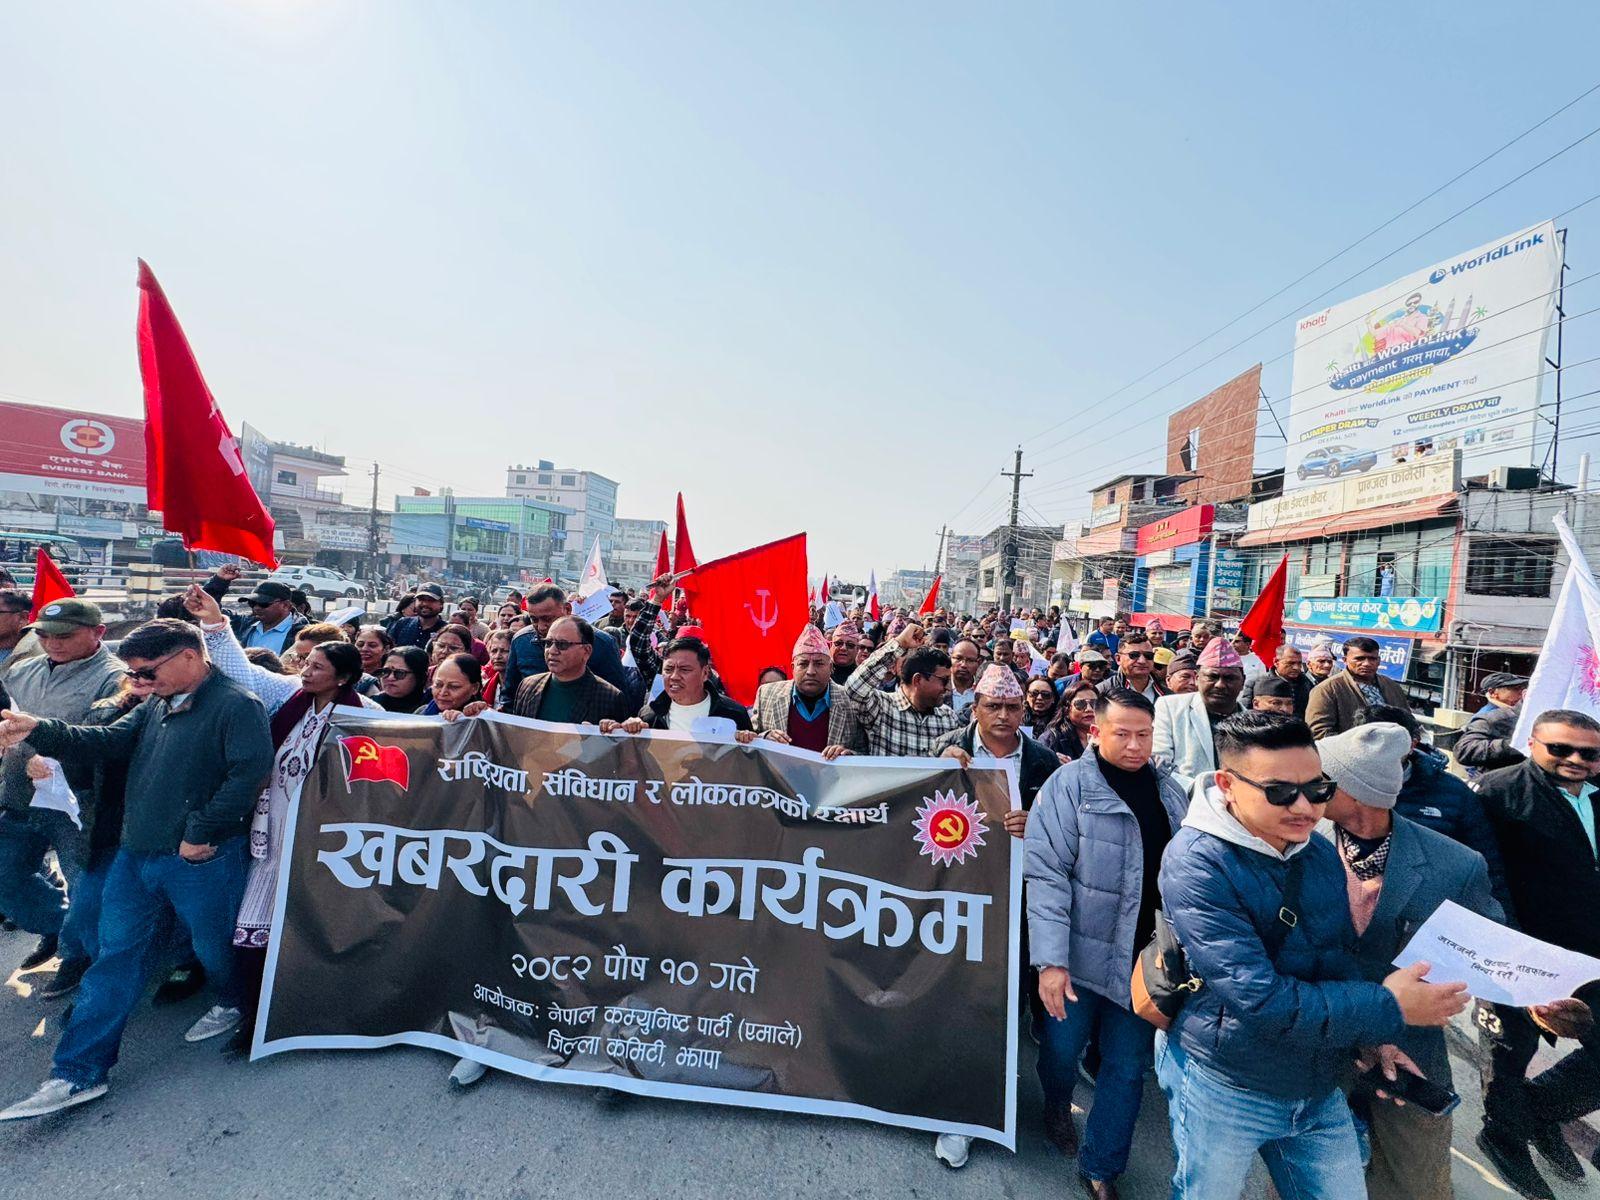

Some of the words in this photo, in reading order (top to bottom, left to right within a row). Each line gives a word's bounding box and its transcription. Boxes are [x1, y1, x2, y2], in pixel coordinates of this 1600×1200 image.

[1450, 233, 1544, 276] WorldLink
[1300, 308, 1330, 331] khalti
[1377, 329, 1463, 361] WORLDLINK
[1349, 358, 1398, 387] payment
[1324, 408, 1346, 420] Khalti
[1360, 395, 1401, 411] WorldLink
[1414, 380, 1461, 398] PAYMENT
[1408, 407, 1451, 424] WEEKLY
[1451, 400, 1486, 414] DRAW
[1300, 423, 1338, 442] BUMPER
[1338, 418, 1368, 430] DRAW
[41, 464, 95, 475] EVEREST
[97, 470, 129, 479] BANK
[542, 768, 638, 803] संविधान
[645, 780, 664, 805] र
[671, 776, 810, 821] लोकतन्त्रको
[813, 802, 889, 825] रक्षार्थ
[317, 822, 639, 916] खबरदारी
[661, 846, 993, 962] कार्यक्रम
[511, 953, 592, 982] २०८२
[603, 944, 650, 982] पौष
[660, 957, 699, 987] १०
[710, 956, 760, 994] गते
[548, 1001, 598, 1027] नेपाल
[603, 1005, 692, 1036] कम्युनिष्ट
[697, 1013, 734, 1039] पार्टी
[738, 1018, 802, 1050] (एमाले)
[1478, 1007, 1501, 1034] 23
[547, 1029, 601, 1056] जिल्ला
[606, 1036, 666, 1068] कमिटी,
[675, 1046, 722, 1070] झापा
